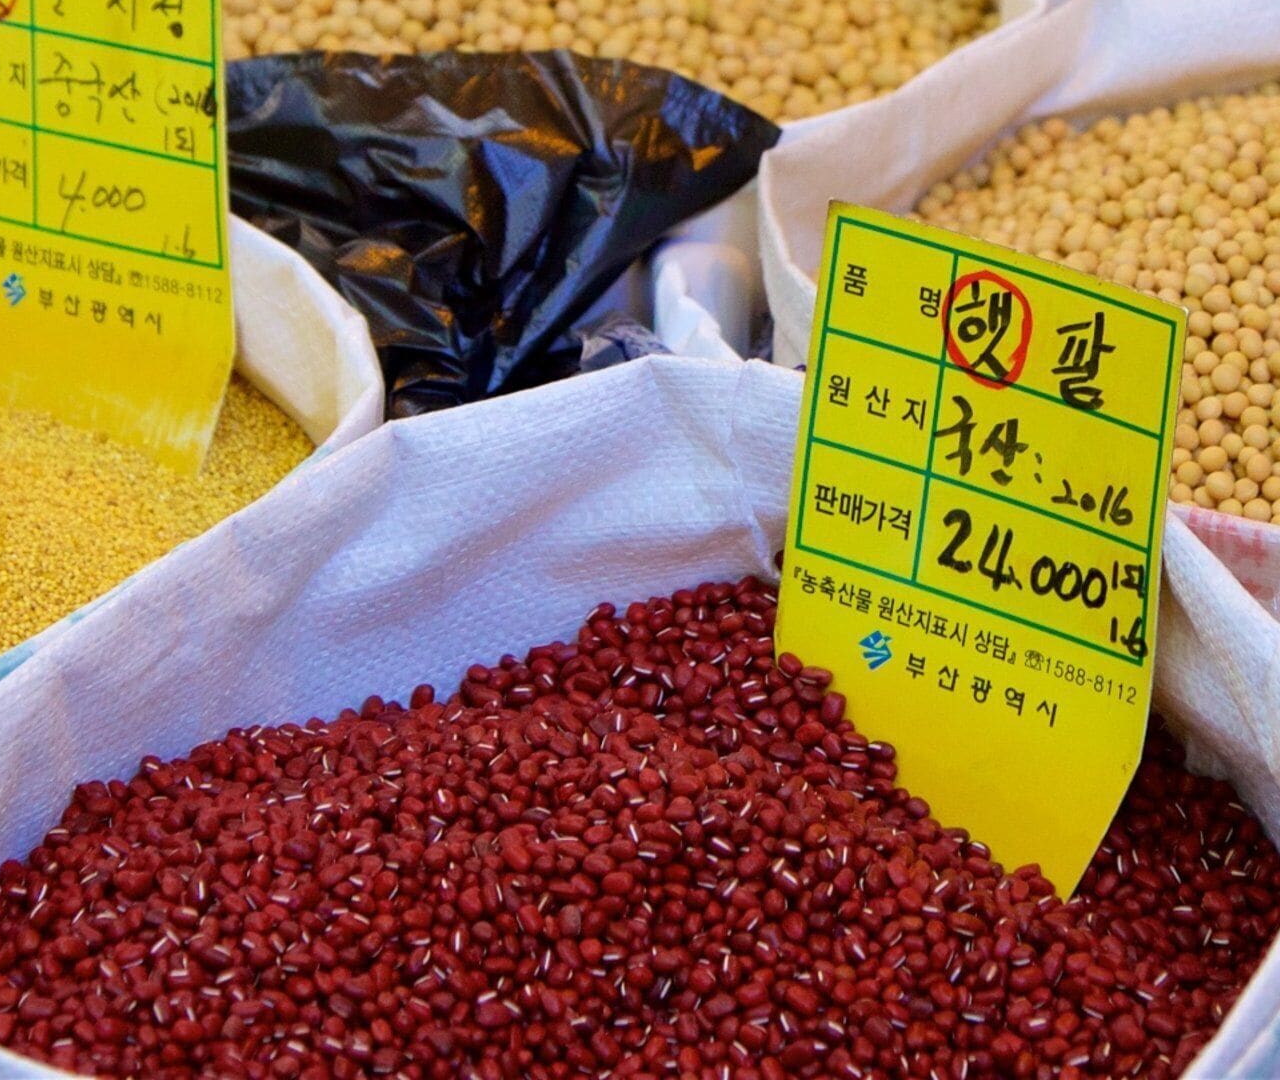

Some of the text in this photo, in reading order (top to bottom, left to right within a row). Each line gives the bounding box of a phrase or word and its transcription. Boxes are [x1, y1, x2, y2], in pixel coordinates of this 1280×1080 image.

[954, 280, 1014, 381] 햇
[814, 483, 912, 541] 판매가격
[936, 507, 1108, 610] 24.000
[1051, 478, 1134, 526] 2016
[877, 595, 969, 648] 원산지표시
[1044, 657, 1139, 705] 1588-8112
